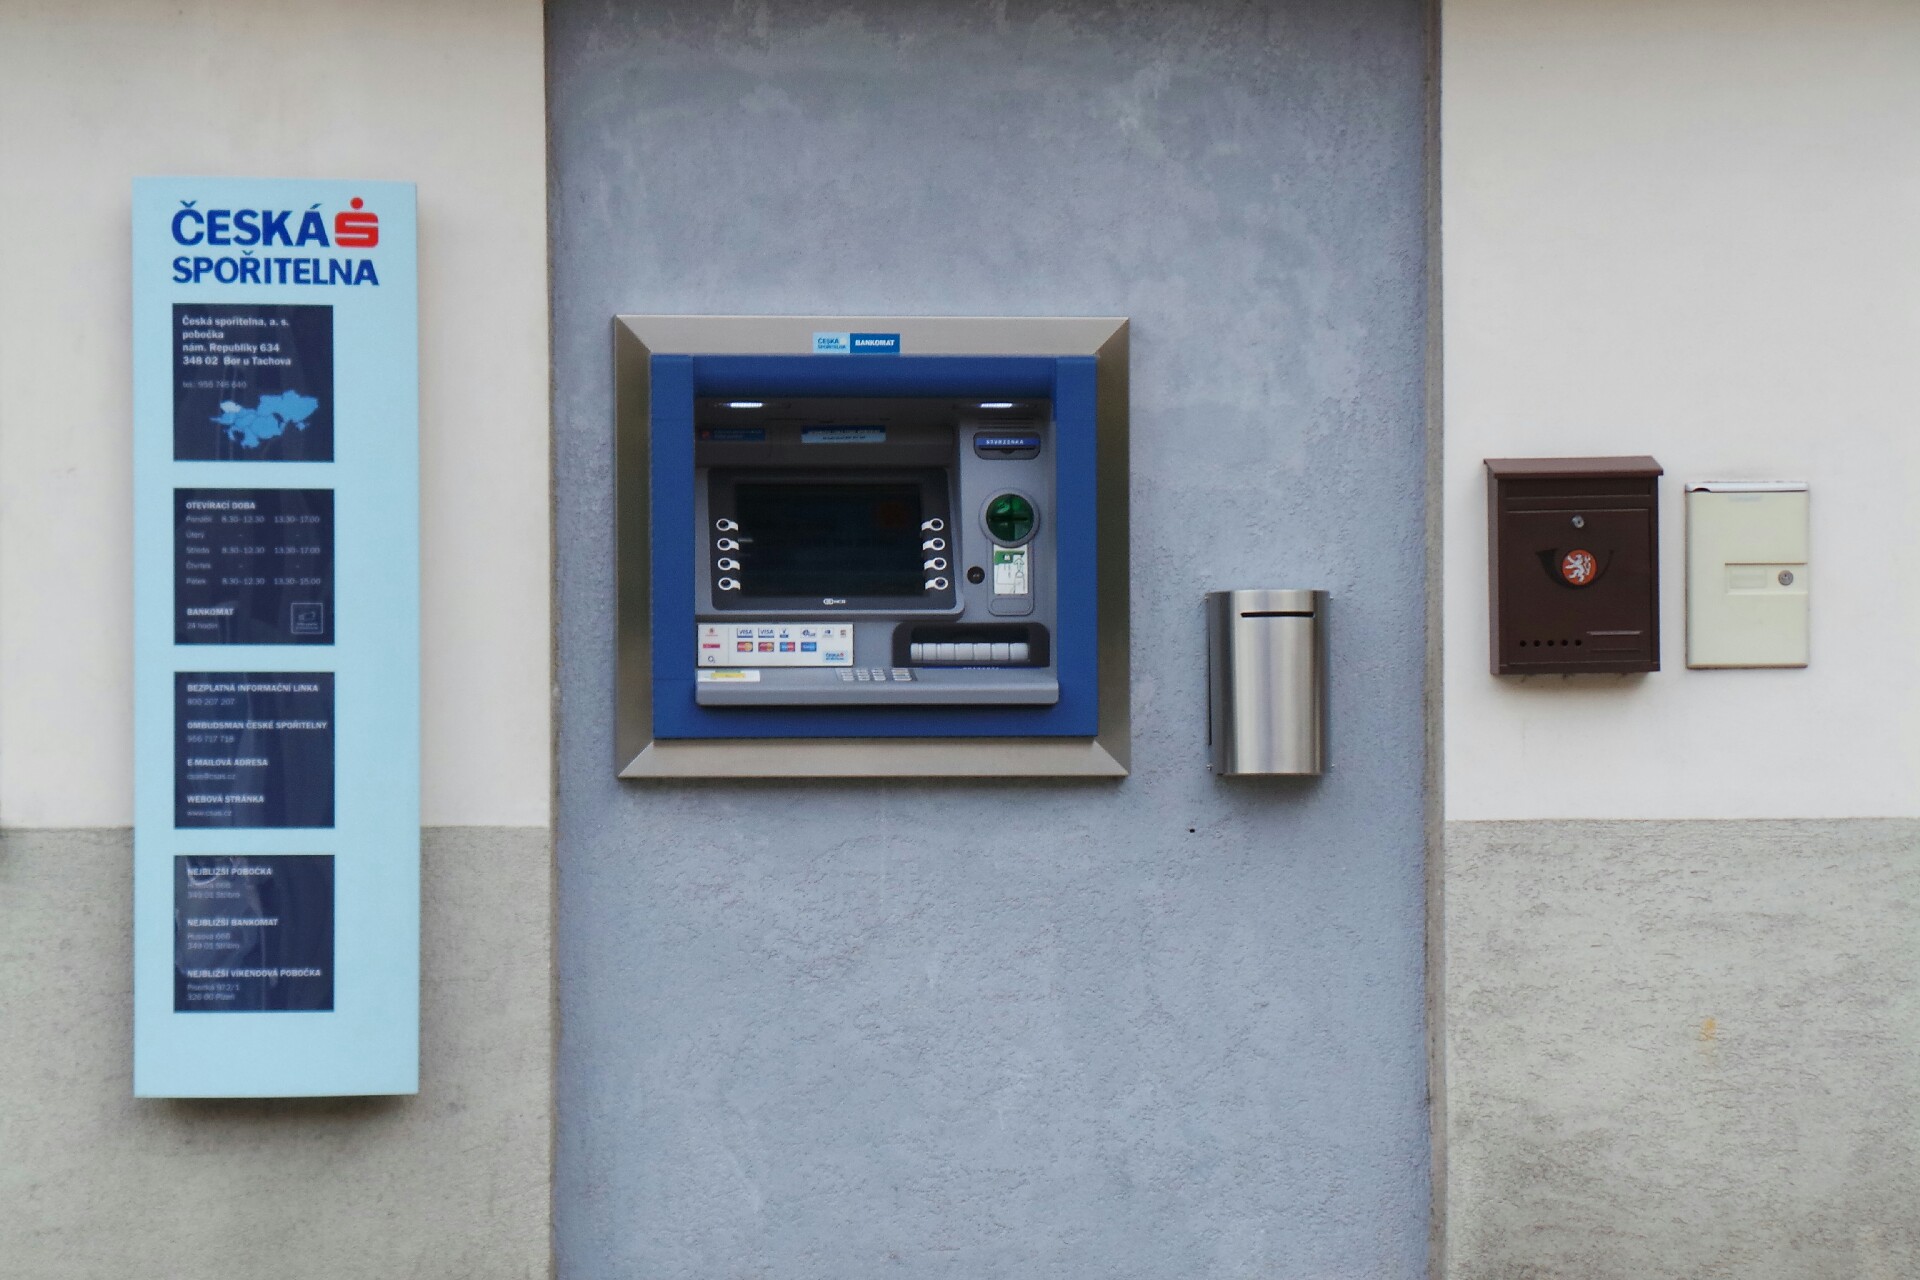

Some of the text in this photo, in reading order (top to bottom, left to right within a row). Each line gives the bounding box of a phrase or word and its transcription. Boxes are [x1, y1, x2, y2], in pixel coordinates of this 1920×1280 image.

[171, 200, 330, 247] ČESKÁ
[172, 250, 379, 286] SPOŘITELNA
[182, 315, 212, 326] Česká
[215, 317, 266, 327] spořitelna,
[182, 330, 224, 340] pobočka
[182, 343, 279, 354] nám. Republiky 634
[183, 357, 202, 365] 348
[205, 357, 218, 365] 02
[224, 357, 240, 365] Bor
[253, 357, 291, 365] Tachova
[186, 501, 229, 509] OTEVÍRACÍ
[187, 683, 235, 692] BEZPLATNÁ
[238, 683, 291, 692] INFORMAČNÍ
[247, 720, 273, 729] ČESKÉ
[276, 720, 327, 729] SPOŘITELNY
[187, 794, 264, 803] WEBOVÁ STRÁNKA
[232, 866, 272, 875] POBOČKA
[231, 918, 278, 926] BANKOMAT
[231, 969, 278, 977] VÍKENDOVÁ
[281, 968, 321, 977] POBOČKA
